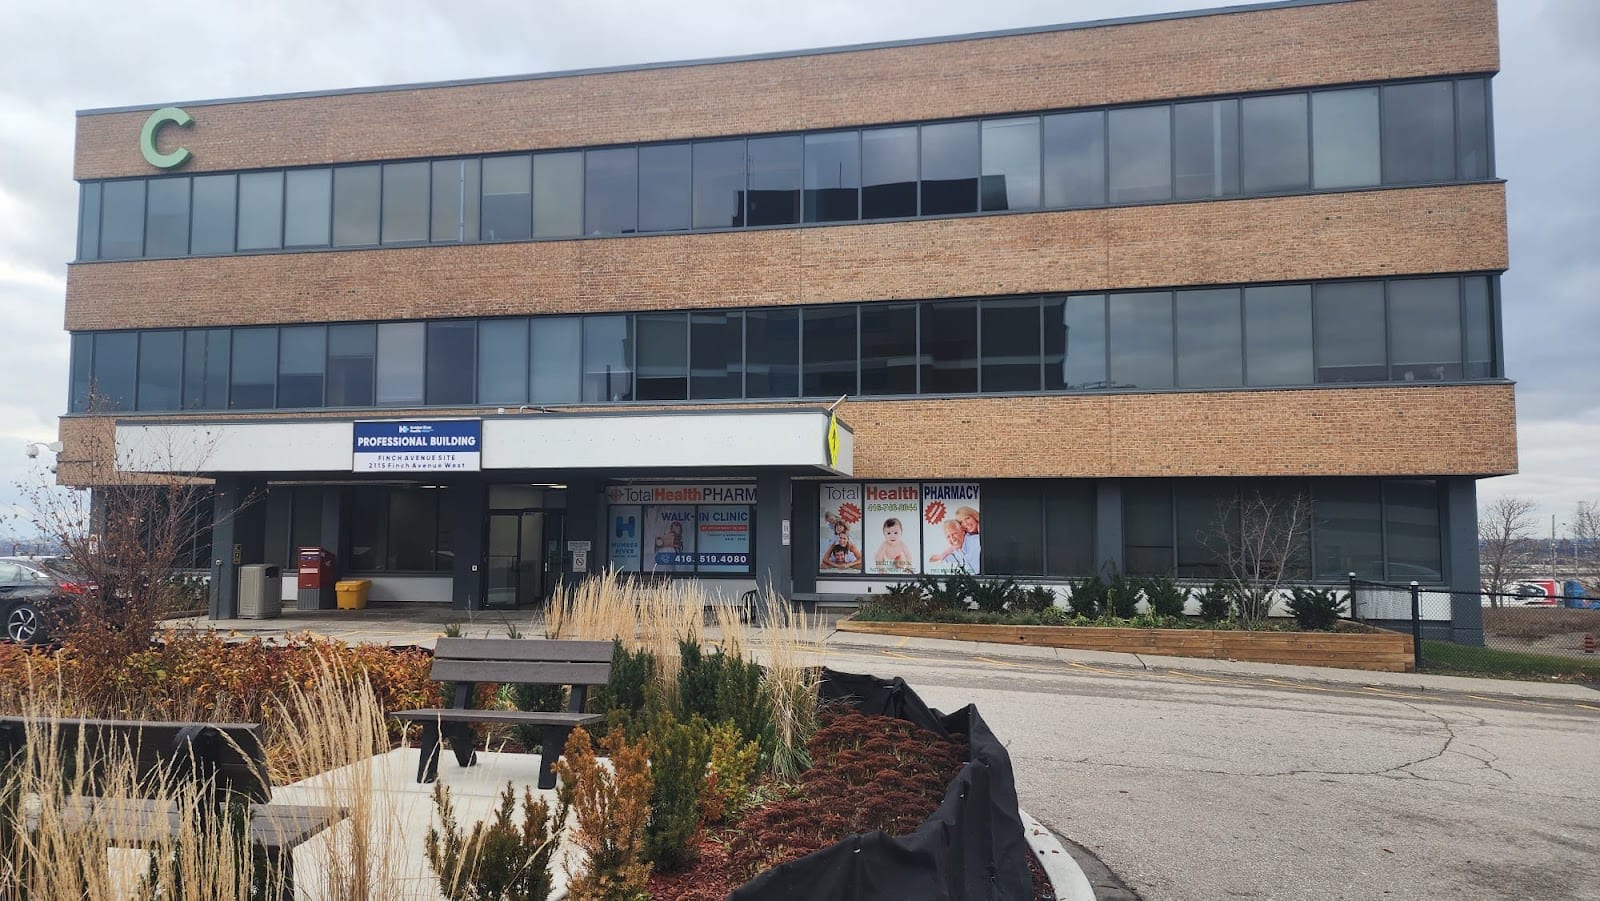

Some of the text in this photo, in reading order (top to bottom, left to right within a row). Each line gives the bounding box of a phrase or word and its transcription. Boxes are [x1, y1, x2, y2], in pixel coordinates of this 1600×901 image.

[141, 107, 193, 169] C
[357, 436, 476, 446] PROFESSIONAL BUILDING
[824, 485, 979, 500] Total Health PHARMACY
[712, 511, 748, 522] CLINIC
